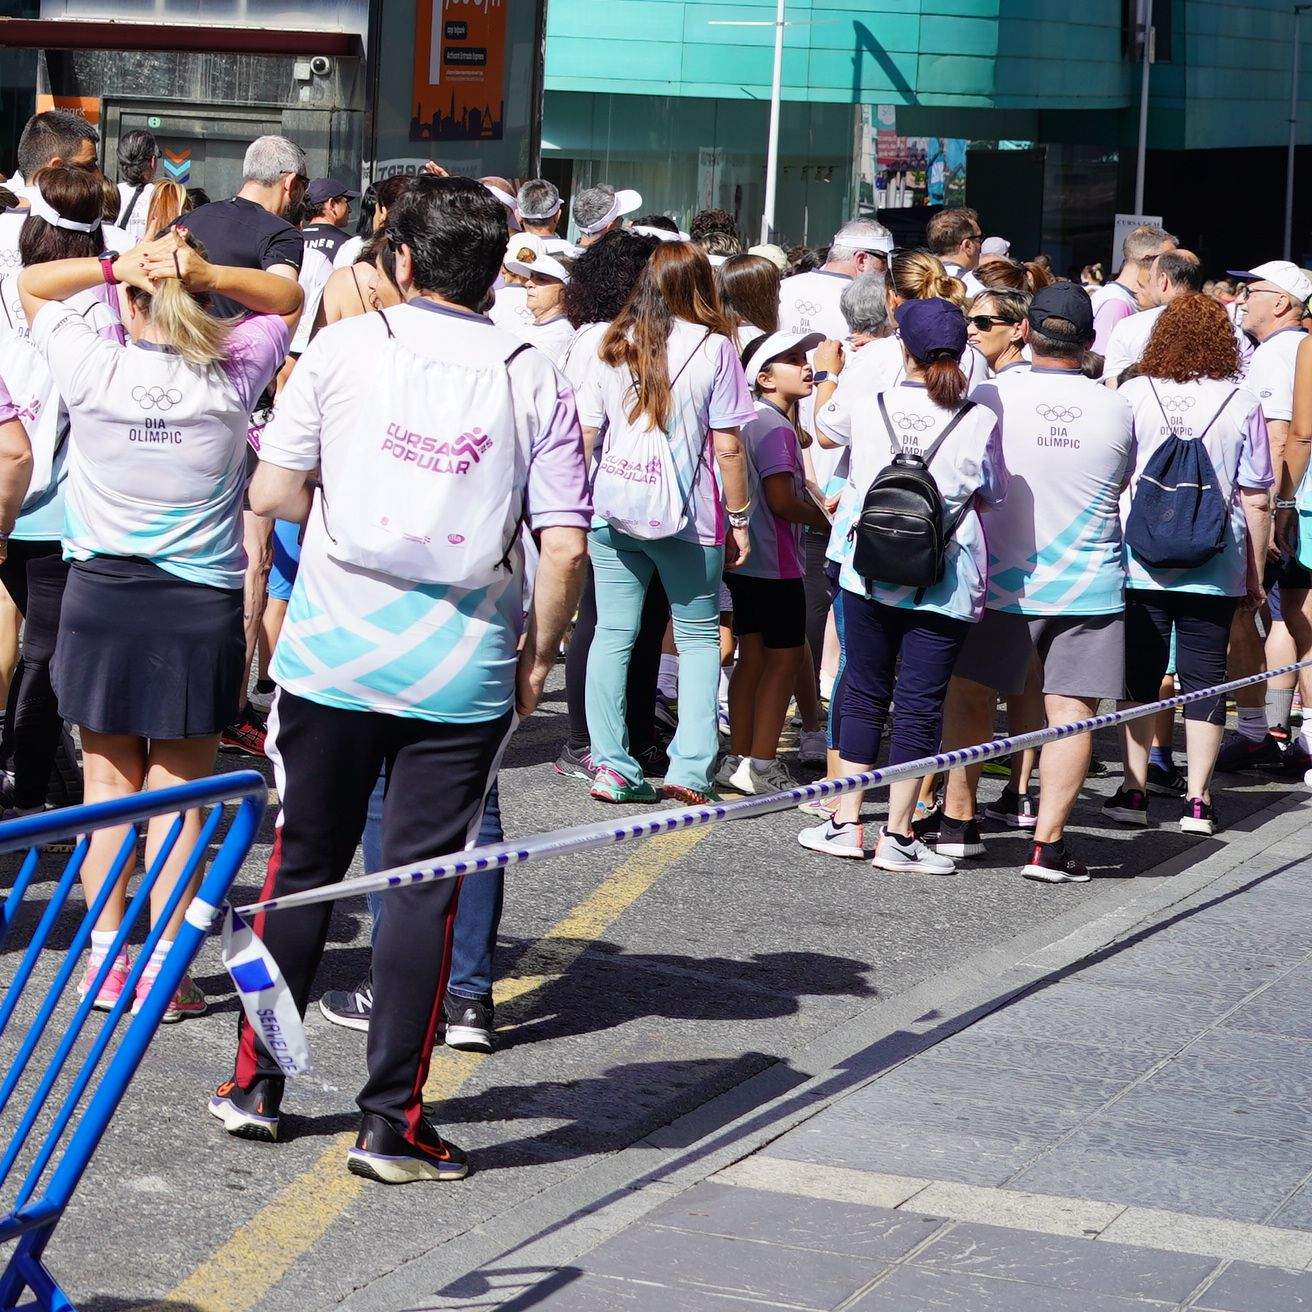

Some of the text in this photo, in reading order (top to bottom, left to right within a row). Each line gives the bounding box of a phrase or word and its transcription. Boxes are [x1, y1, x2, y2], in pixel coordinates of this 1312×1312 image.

[145, 418, 166, 429] DIA
[1170, 416, 1183, 426] DIA
[1050, 426, 1068, 437] DIA
[902, 434, 919, 446] DIA
[381, 437, 471, 475] POPULAR
